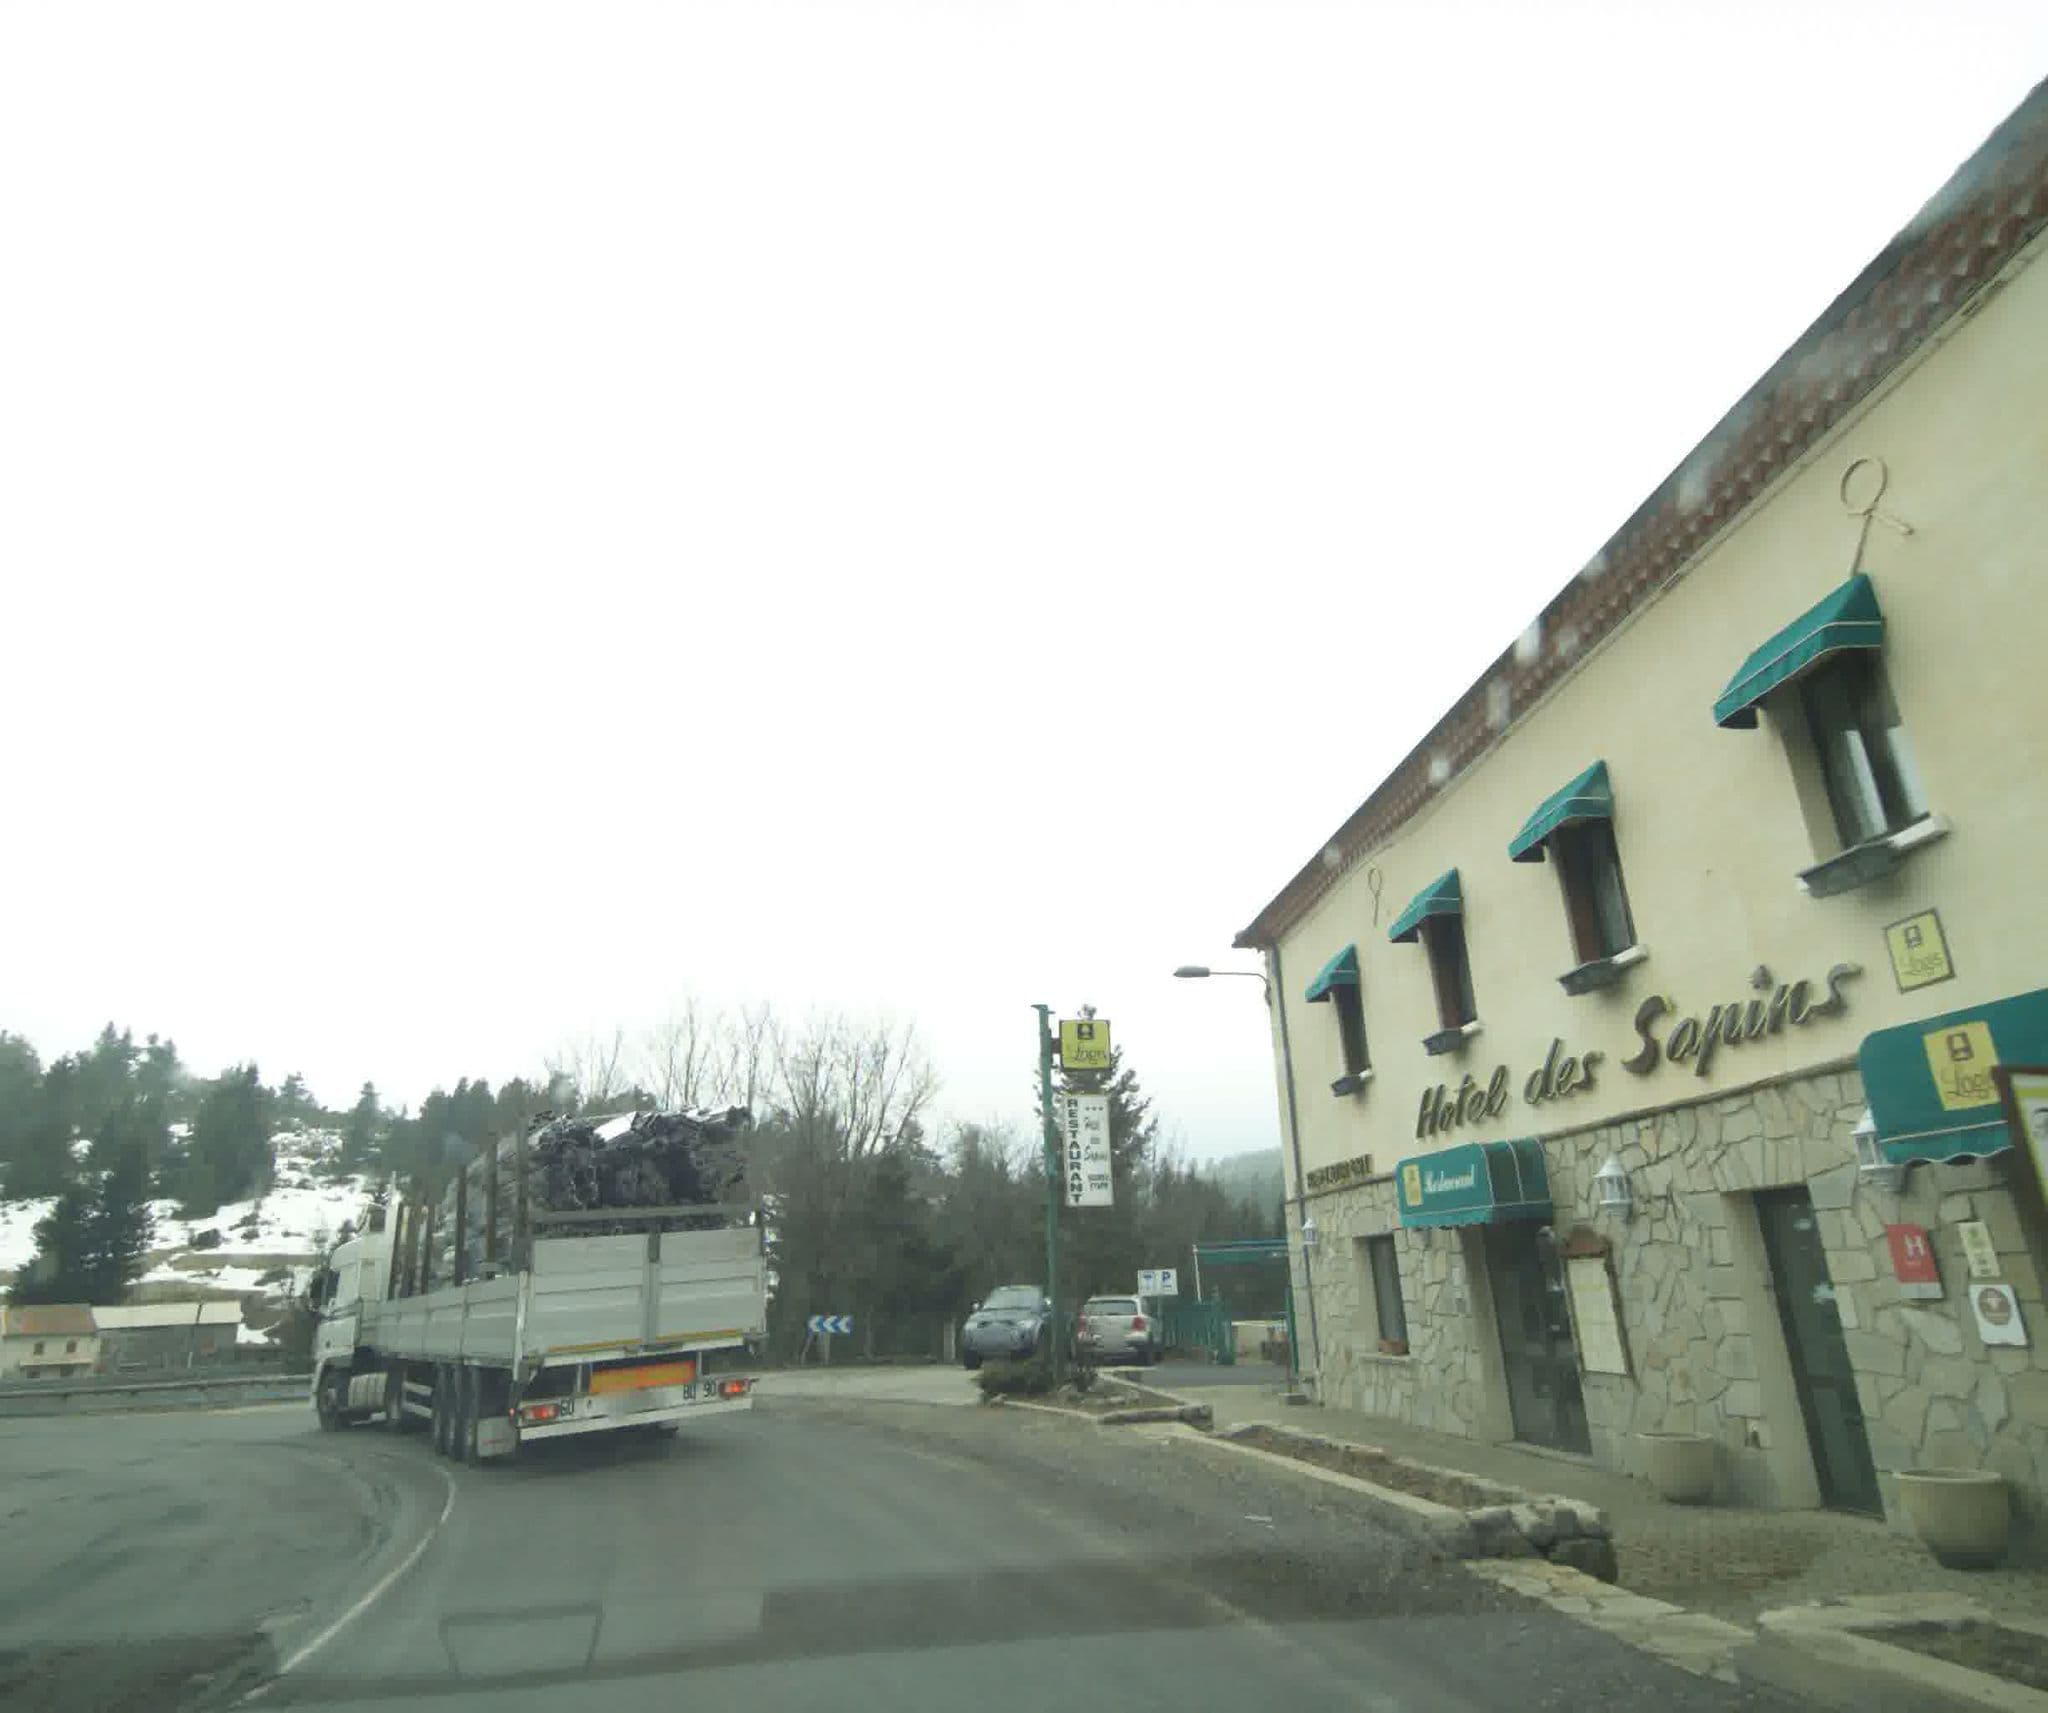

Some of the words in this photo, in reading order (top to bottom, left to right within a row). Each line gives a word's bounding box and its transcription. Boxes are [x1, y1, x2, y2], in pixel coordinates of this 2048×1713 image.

[1523, 1036, 1606, 1105] des
[1620, 962, 1864, 1078] Sapins
[1067, 1098, 1083, 1204] RESTAURANT
[703, 1382, 718, 1398] 90
